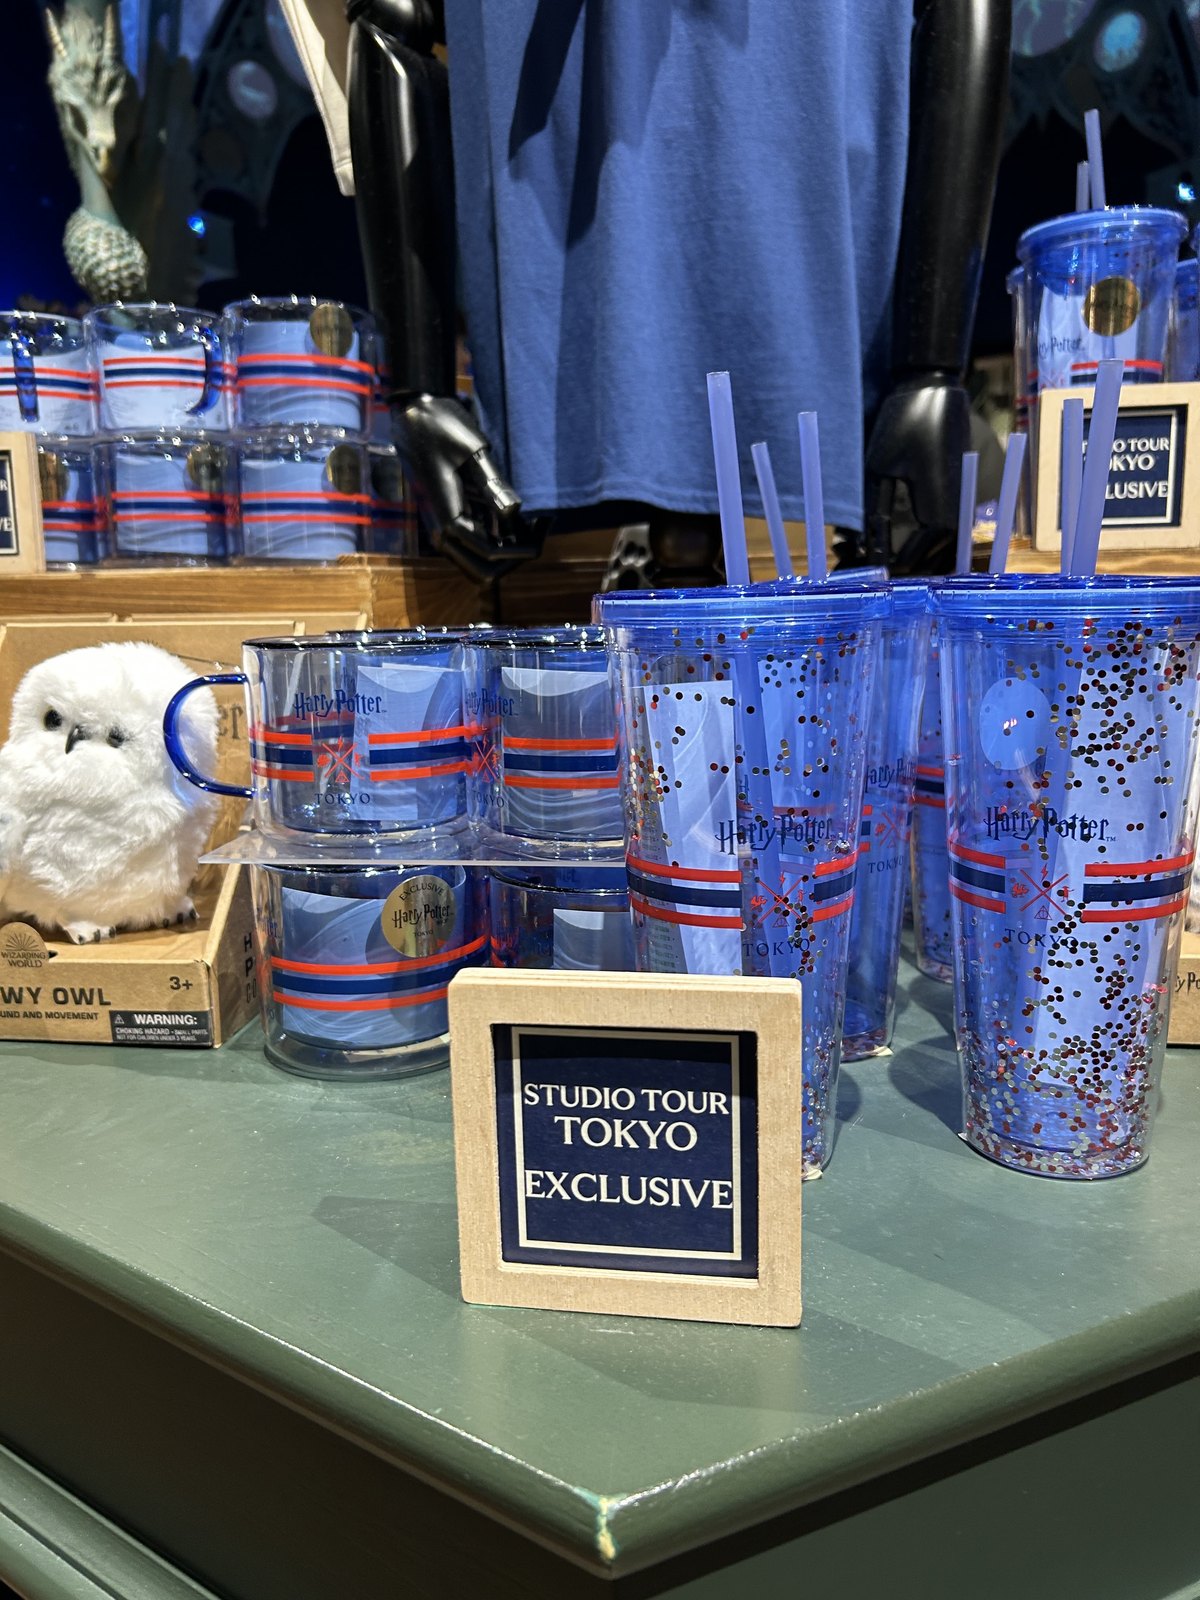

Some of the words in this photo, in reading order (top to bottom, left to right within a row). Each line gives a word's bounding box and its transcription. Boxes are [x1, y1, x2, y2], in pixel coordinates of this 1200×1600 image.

[1128, 437, 1169, 452] TOUR
[1110, 453, 1155, 471] KYO
[1105, 481, 1168, 500] LUSIVE
[294, 692, 333, 720] Harry
[334, 690, 382, 716] Potter
[315, 793, 371, 805] TOKYO
[983, 806, 1039, 840] Harry
[1043, 807, 1109, 842] Potter
[715, 819, 777, 855] Harry
[780, 814, 833, 853] Potter
[399, 883, 445, 901] EXCLUSIVE
[392, 909, 422, 929] Harry
[423, 903, 450, 924] Potter
[1, 951, 46, 960] WIZARDING
[742, 938, 810, 957] TOKYO
[8, 959, 42, 968] WORLD
[169, 976, 194, 990] 3+
[53, 987, 111, 1006] OWL
[23, 1011, 42, 1019] AND
[45, 1011, 99, 1020] MOVEMENT
[134, 1014, 198, 1025] WARNING:
[524, 1083, 635, 1111] STUDIO
[641, 1089, 730, 1115] TOUR
[554, 1116, 698, 1152] TOKYO
[524, 1169, 733, 1209] EXCLUSIVE
